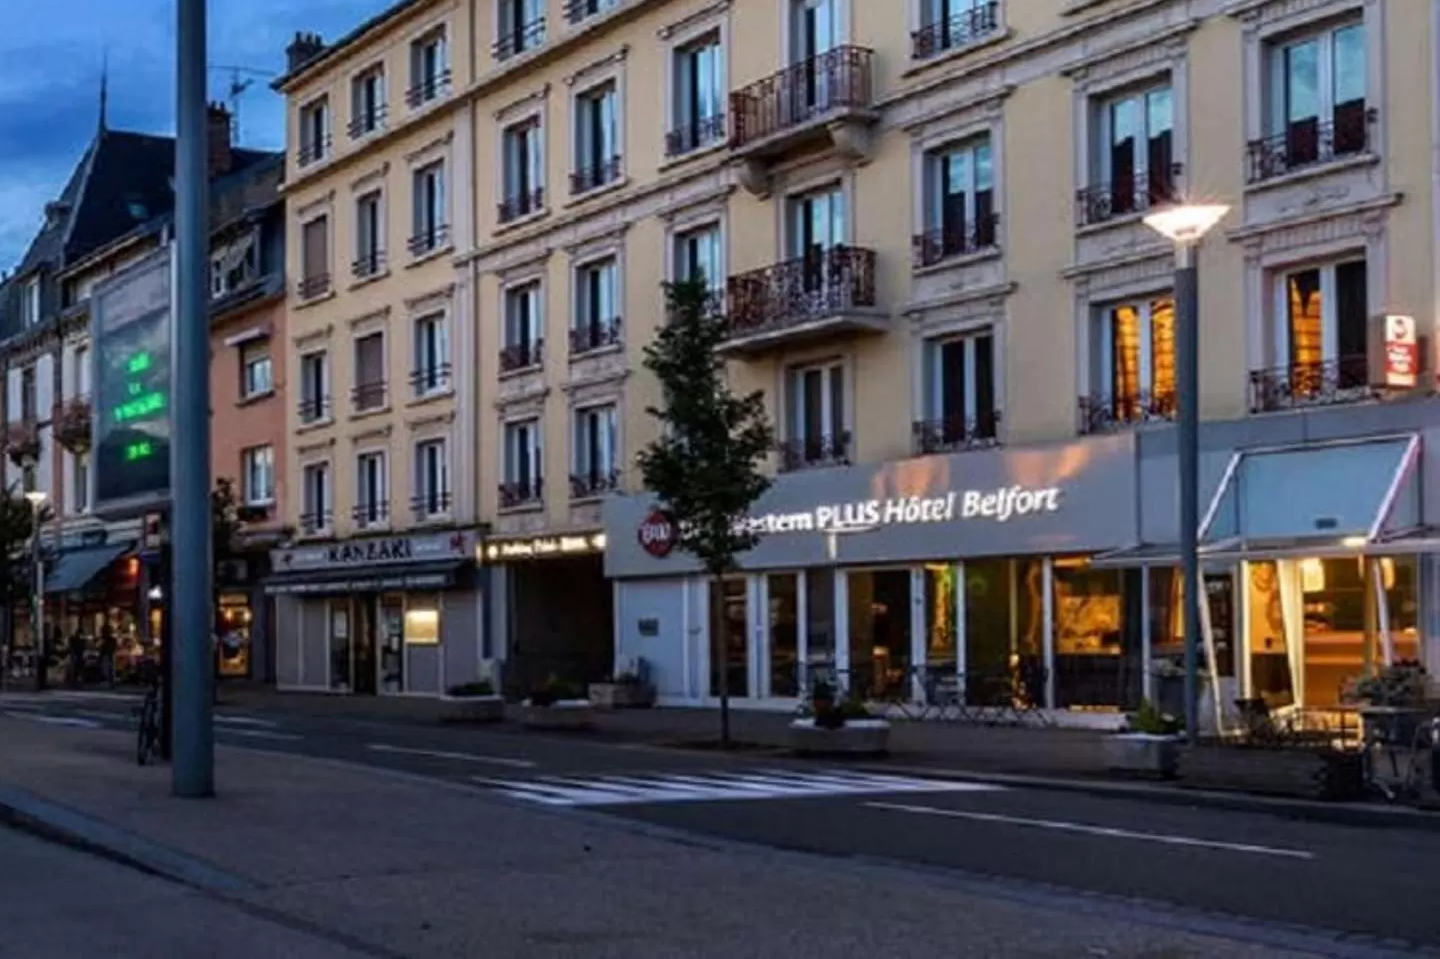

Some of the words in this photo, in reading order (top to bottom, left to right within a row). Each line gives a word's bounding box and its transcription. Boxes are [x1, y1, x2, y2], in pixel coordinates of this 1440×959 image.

[816, 499, 879, 529] PLUS
[883, 491, 957, 524] Hôtel
[963, 484, 1060, 522] Belfort
[327, 535, 414, 563] KANZAKI
